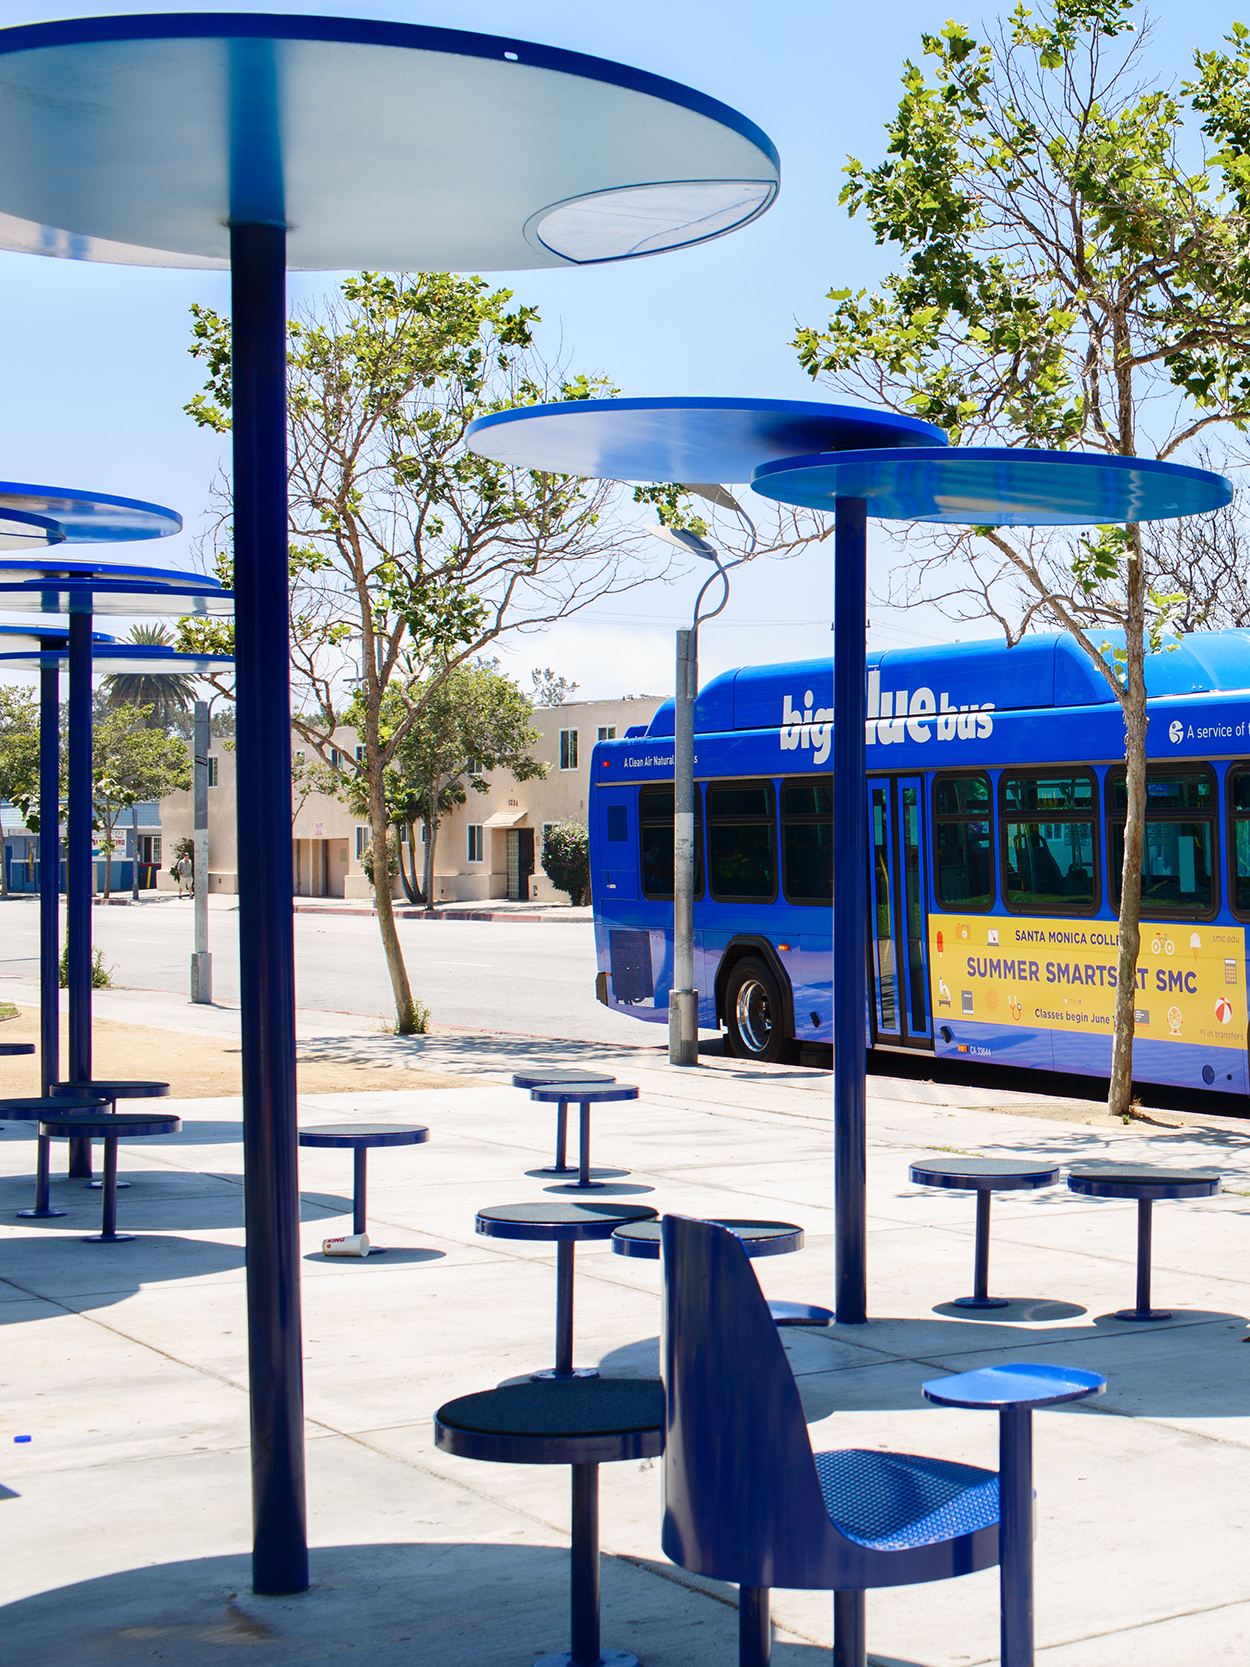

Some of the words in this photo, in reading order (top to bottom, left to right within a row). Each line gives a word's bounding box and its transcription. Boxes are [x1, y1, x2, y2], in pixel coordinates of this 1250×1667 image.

[780, 689, 834, 764] big
[866, 666, 936, 745] lue
[937, 692, 996, 741] bus
[1187, 725, 1195, 739] A
[1197, 724, 1232, 739] service
[1235, 721, 1246, 736] of
[624, 758, 628, 768] A
[629, 757, 644, 767] Clean
[644, 756, 653, 767] Air
[653, 755, 675, 766] Natural
[1015, 929, 1046, 942] SANTA
[1049, 931, 1088, 945] MONICA
[1211, 934, 1240, 945] smc.edu
[967, 956, 1041, 982] SUMMER
[1045, 961, 1118, 988] SMARTS
[1155, 969, 1198, 995] SMC
[1034, 1008, 1063, 1022] Classes
[1066, 1009, 1089, 1024] begin
[1091, 1012, 1110, 1024] June
[1207, 1029, 1213, 1038] in
[1215, 1031, 1244, 1041] transfers
[969, 1046, 977, 1055] CA
